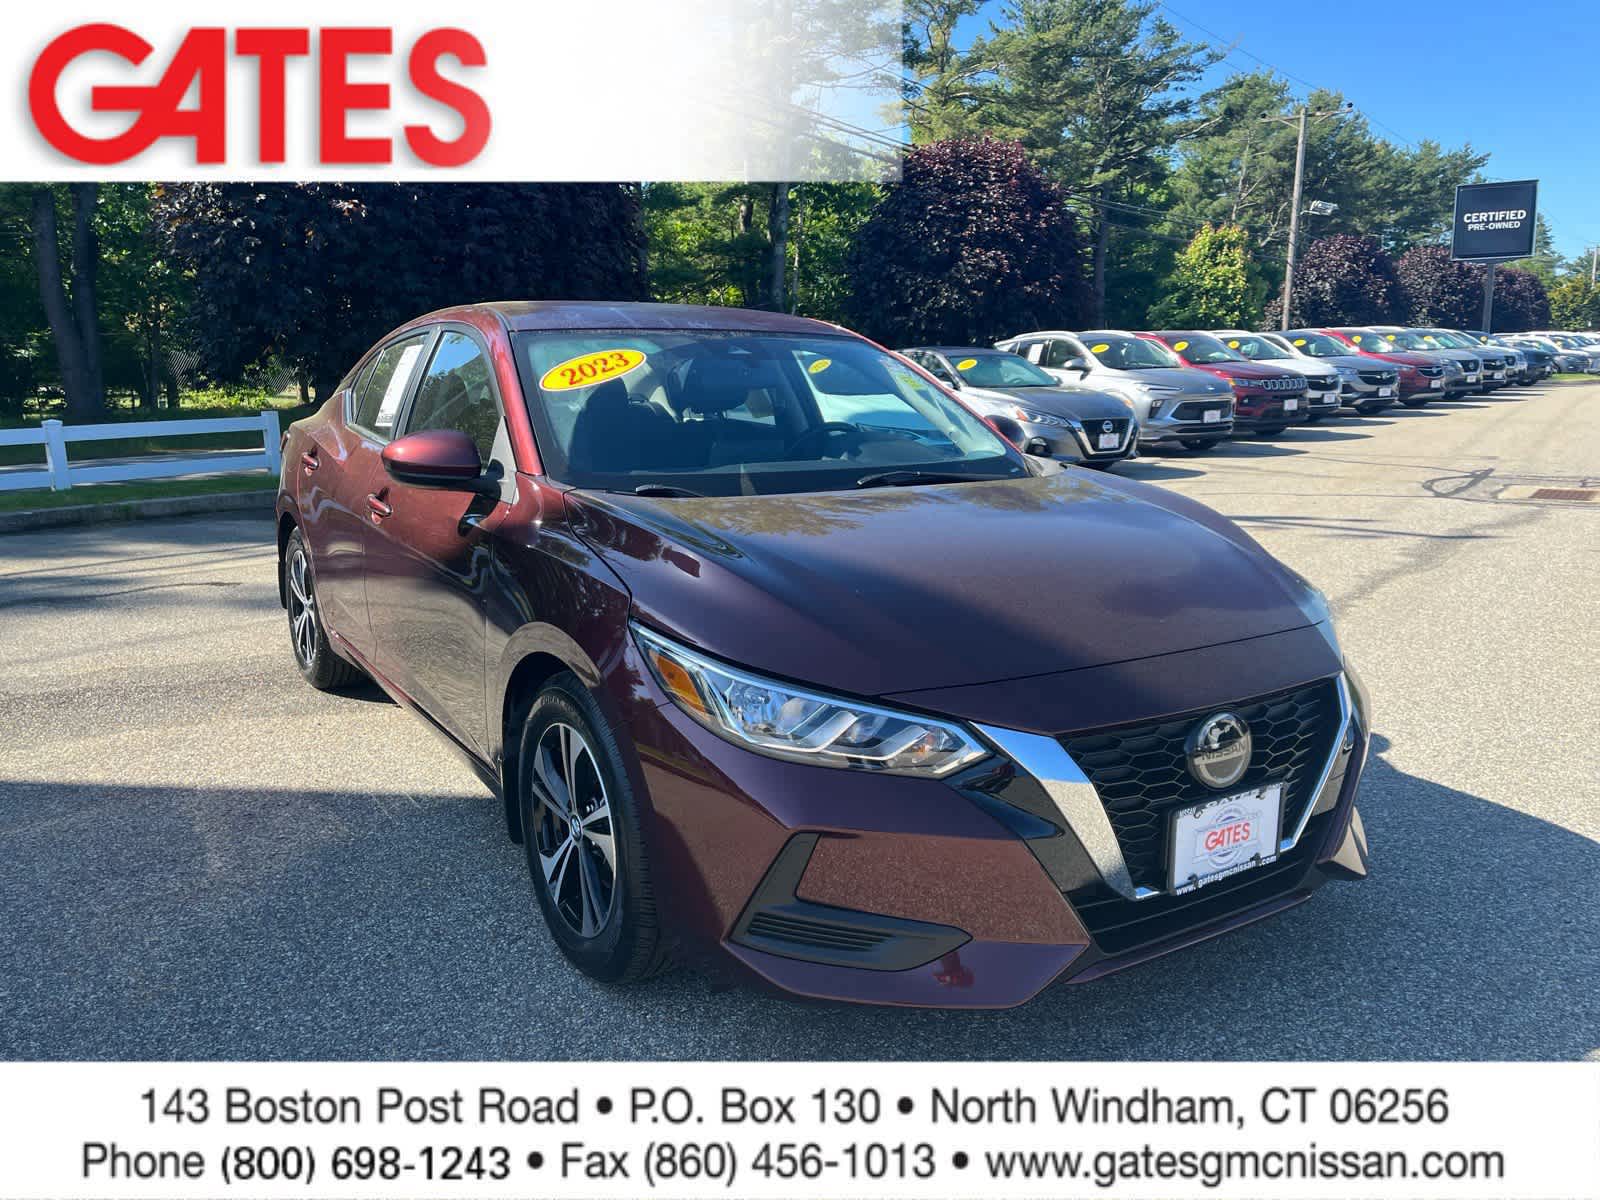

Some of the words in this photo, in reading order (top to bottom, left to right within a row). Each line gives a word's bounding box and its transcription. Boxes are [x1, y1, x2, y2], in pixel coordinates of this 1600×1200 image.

[1463, 209, 1527, 223] CERTIFIED
[1467, 221, 1521, 231] PRE-OWNED
[560, 352, 630, 386] 2023
[1202, 741, 1246, 761] NISSAN
[1204, 822, 1251, 851] GATES
